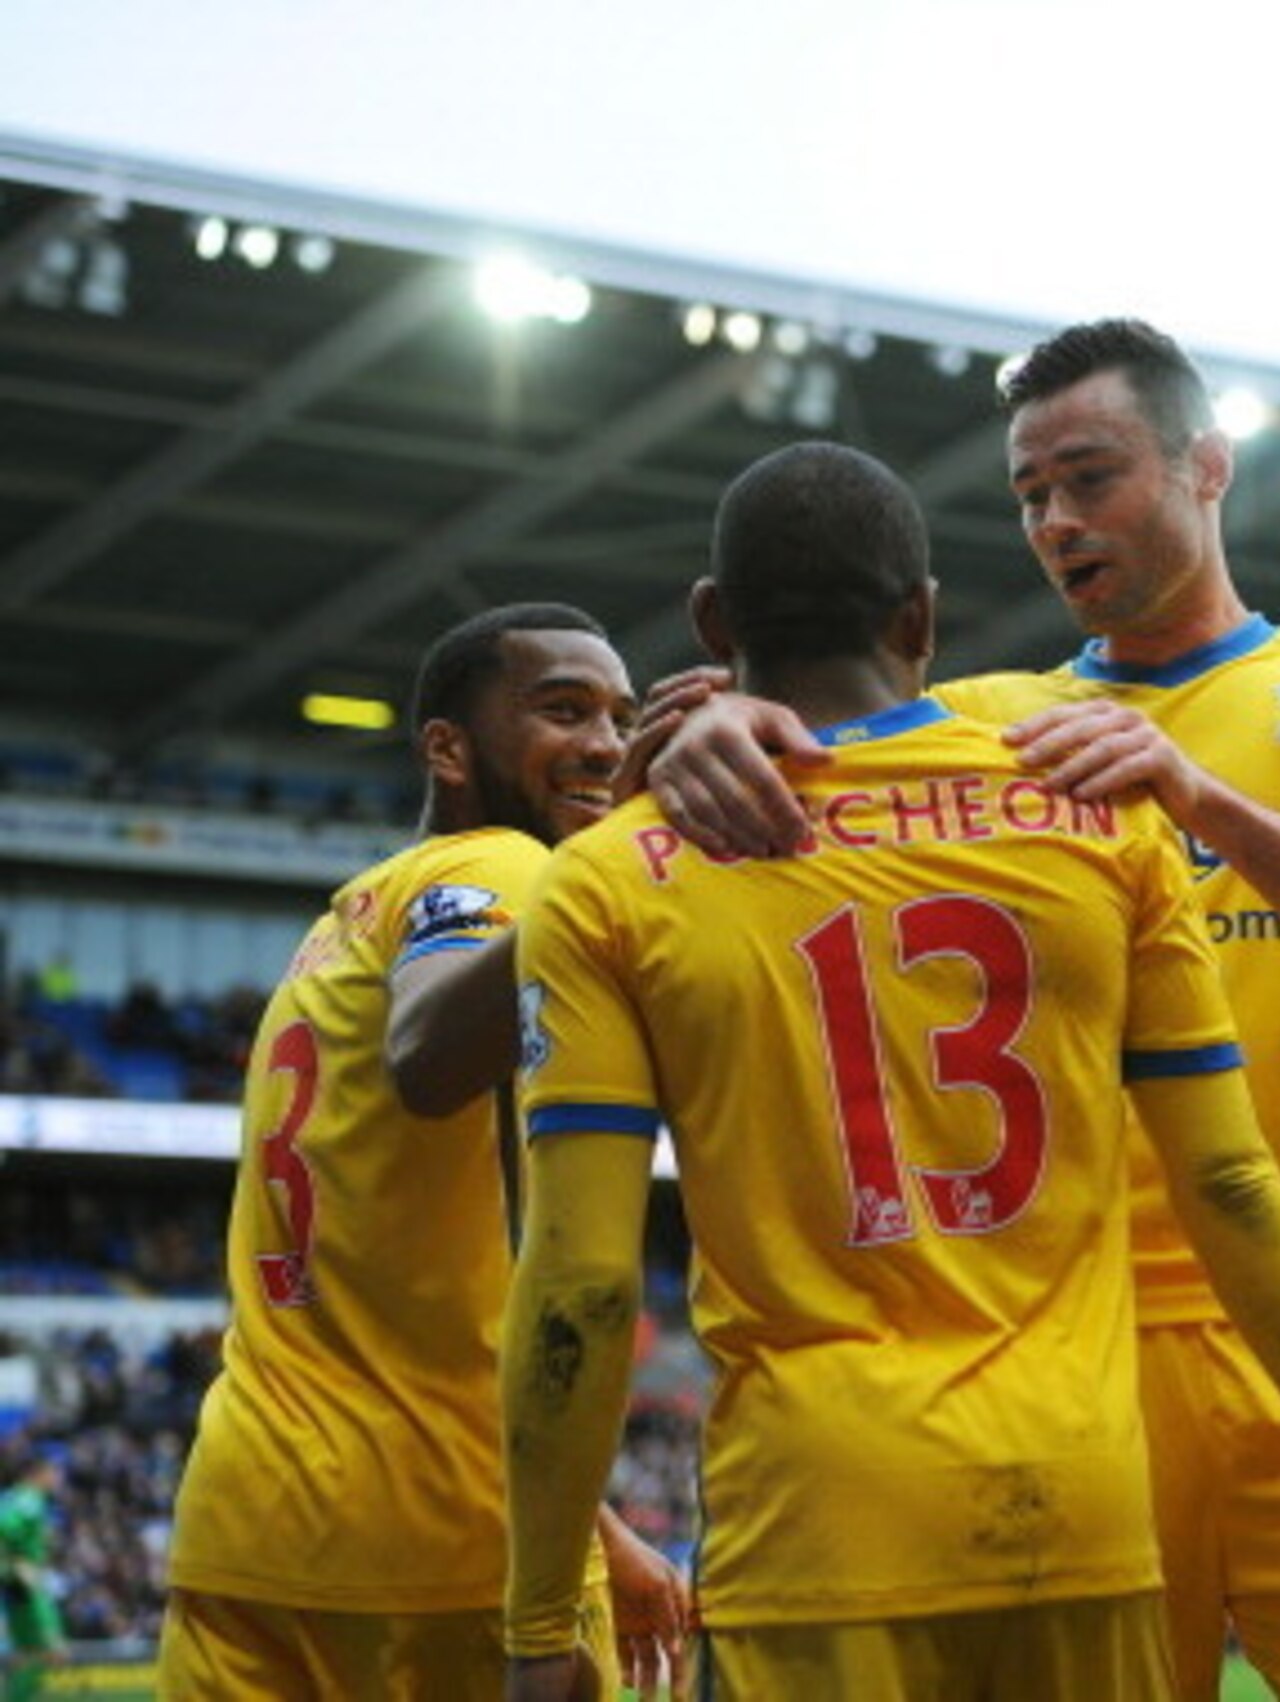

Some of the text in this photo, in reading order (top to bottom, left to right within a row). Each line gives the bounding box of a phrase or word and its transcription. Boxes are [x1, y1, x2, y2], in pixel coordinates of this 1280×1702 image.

[635, 777, 1119, 883] PCHEON
[255, 1021, 318, 1308] 3
[795, 893, 1048, 1247] 13
